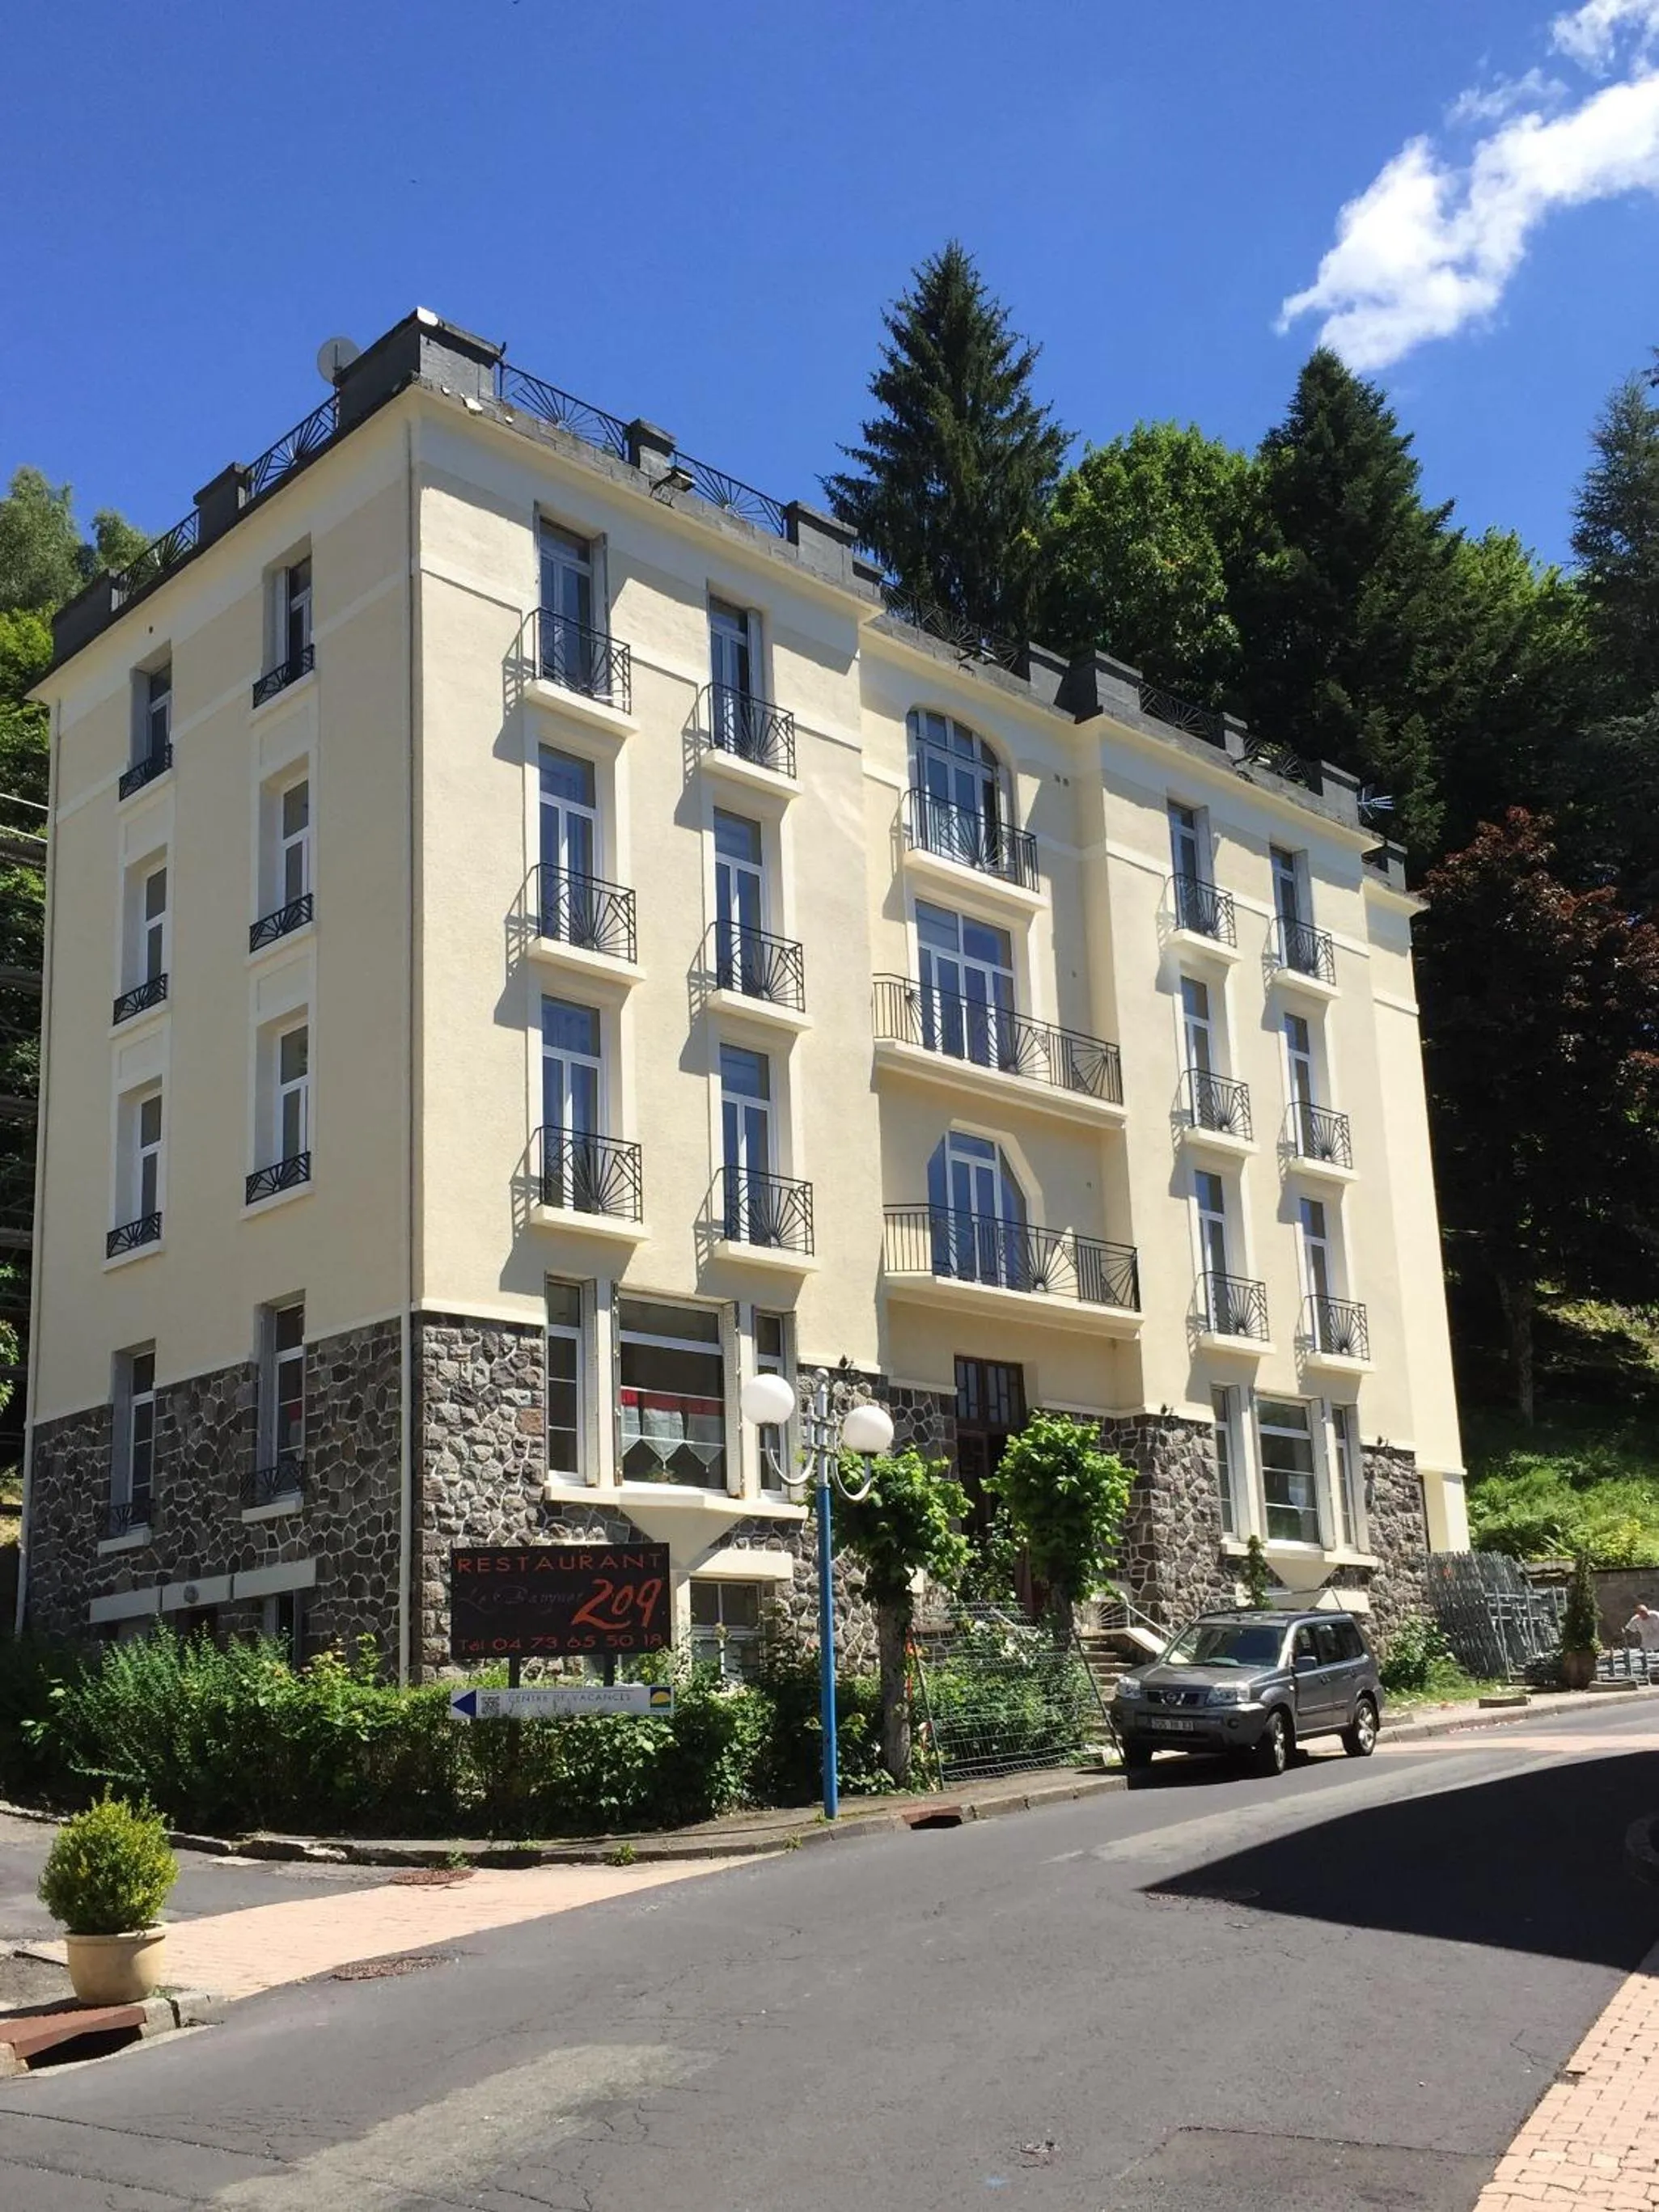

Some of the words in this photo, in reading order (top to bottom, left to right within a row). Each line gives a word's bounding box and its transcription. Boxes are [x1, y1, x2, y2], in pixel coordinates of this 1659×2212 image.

[456, 1553, 662, 1574] RESTAURANT
[570, 1578, 662, 1630] 209
[493, 1637, 522, 1651] 04
[530, 1635, 557, 1649] 73
[567, 1635, 596, 1648] 65
[605, 1634, 634, 1647] 50
[573, 1692, 632, 1702] VACANCES
